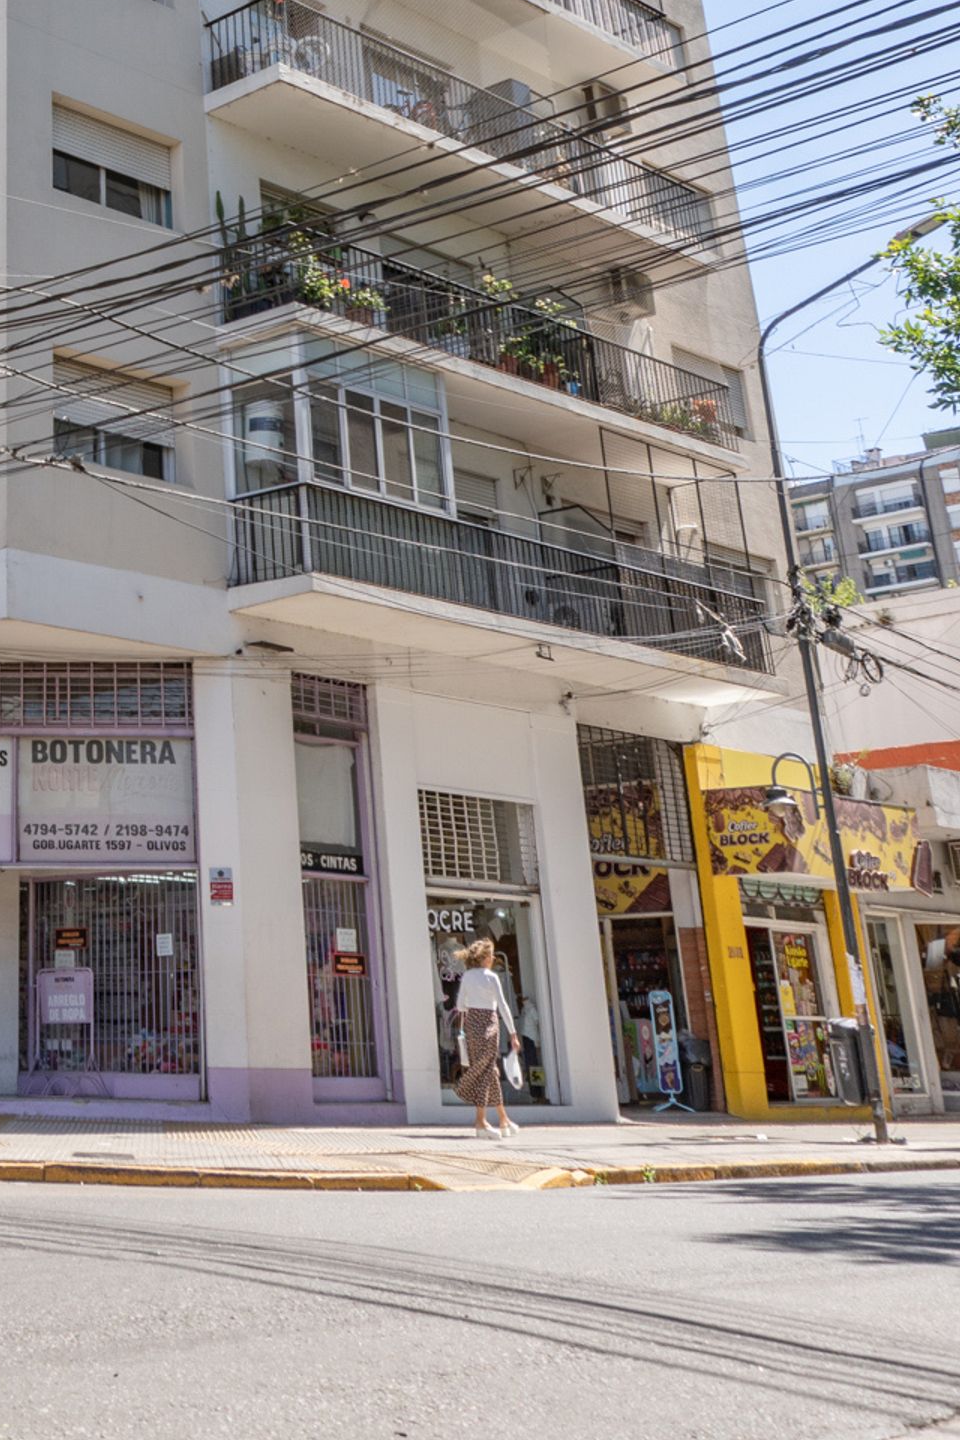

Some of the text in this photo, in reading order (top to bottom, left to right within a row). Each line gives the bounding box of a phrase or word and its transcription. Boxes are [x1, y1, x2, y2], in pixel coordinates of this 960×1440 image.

[31, 739, 176, 765] BOTONERA
[32, 765, 98, 793] NORTE
[23, 824, 99, 836] 4794-5742
[115, 824, 190, 837] 2198-9474
[32, 840, 101, 851] GOB.UGARTE
[106, 840, 132, 851] 1597
[146, 840, 187, 852] OLIVOS
[720, 832, 770, 847] BLOCK
[320, 855, 357, 872] CINTAS
[848, 869, 889, 891] BLOCK
[48, 993, 86, 1007] ARREGLO
[49, 1007, 86, 1021] DE ROPA
